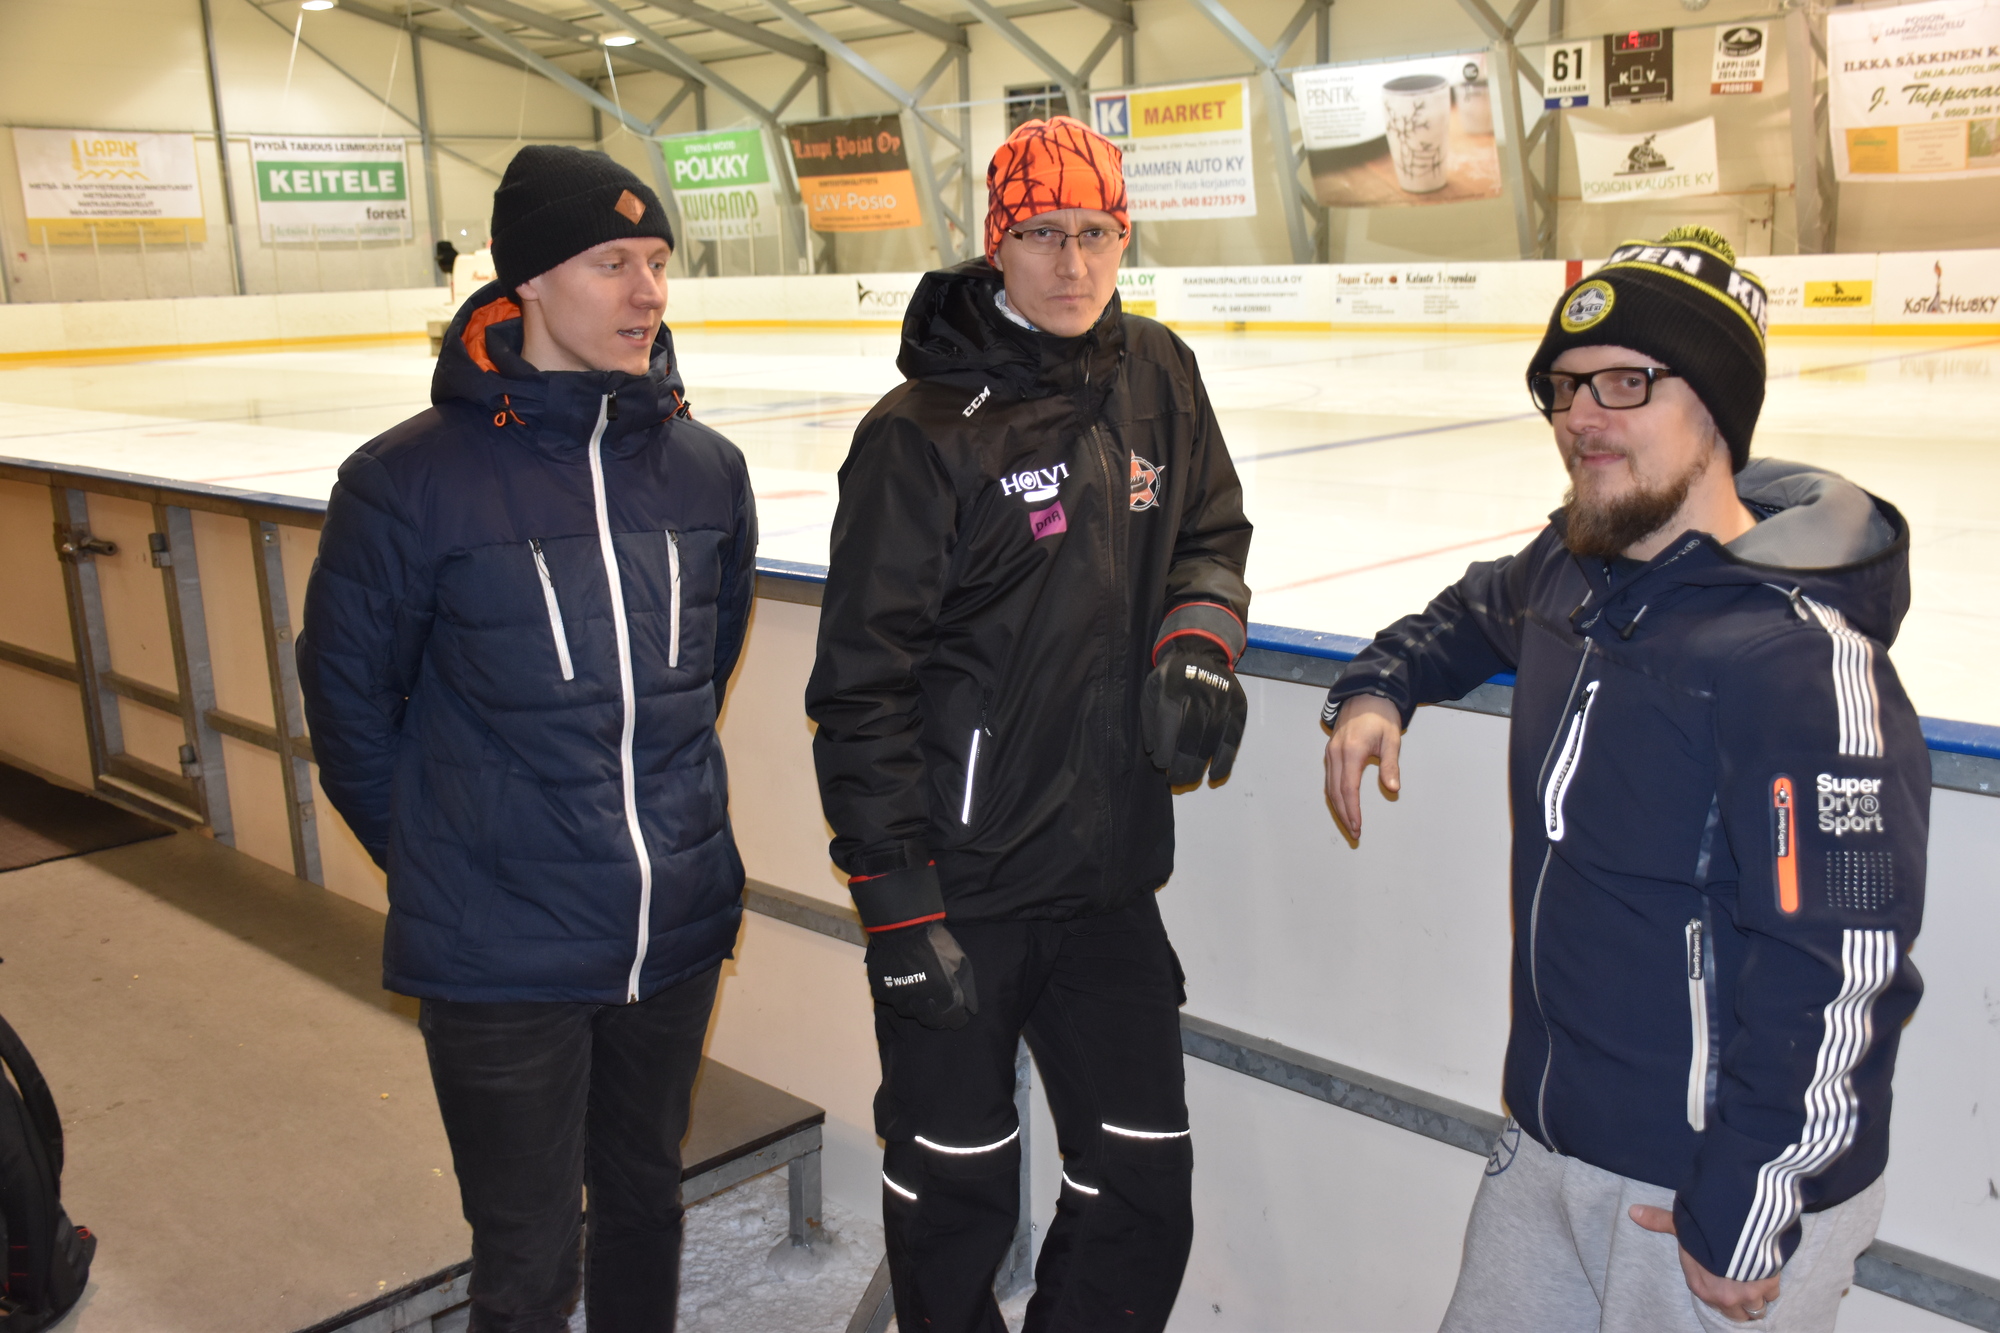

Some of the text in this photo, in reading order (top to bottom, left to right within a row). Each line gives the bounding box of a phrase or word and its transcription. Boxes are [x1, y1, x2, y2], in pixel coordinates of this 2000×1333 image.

[1553, 47, 1583, 81] 61
[1843, 45, 2000, 73] ILKKA SÄKKINEN K
[1619, 71, 1629, 85] K
[1646, 69, 1656, 83] V
[1913, 61, 2000, 80] LINJA-AUTOLIIK
[1306, 85, 1356, 106] PENTIK
[1099, 100, 1227, 135] K MARKET
[83, 139, 138, 157] LAPIN
[1123, 156, 1244, 178] ILAMMEN AUTO KY
[269, 169, 397, 194] KEITELE
[1584, 172, 1714, 194] POSION KALUSTE KY
[366, 207, 407, 220] forest
[1181, 197, 1199, 208] 040
[1138, 273, 1156, 287] OY
[962, 385, 991, 418] CCM
[1000, 462, 1070, 496] HOLVI
[1197, 668, 1230, 693] WÜRTH
[1816, 773, 1882, 797] Super
[1818, 811, 1884, 836] Sport
[893, 971, 927, 987] WÜRTH
